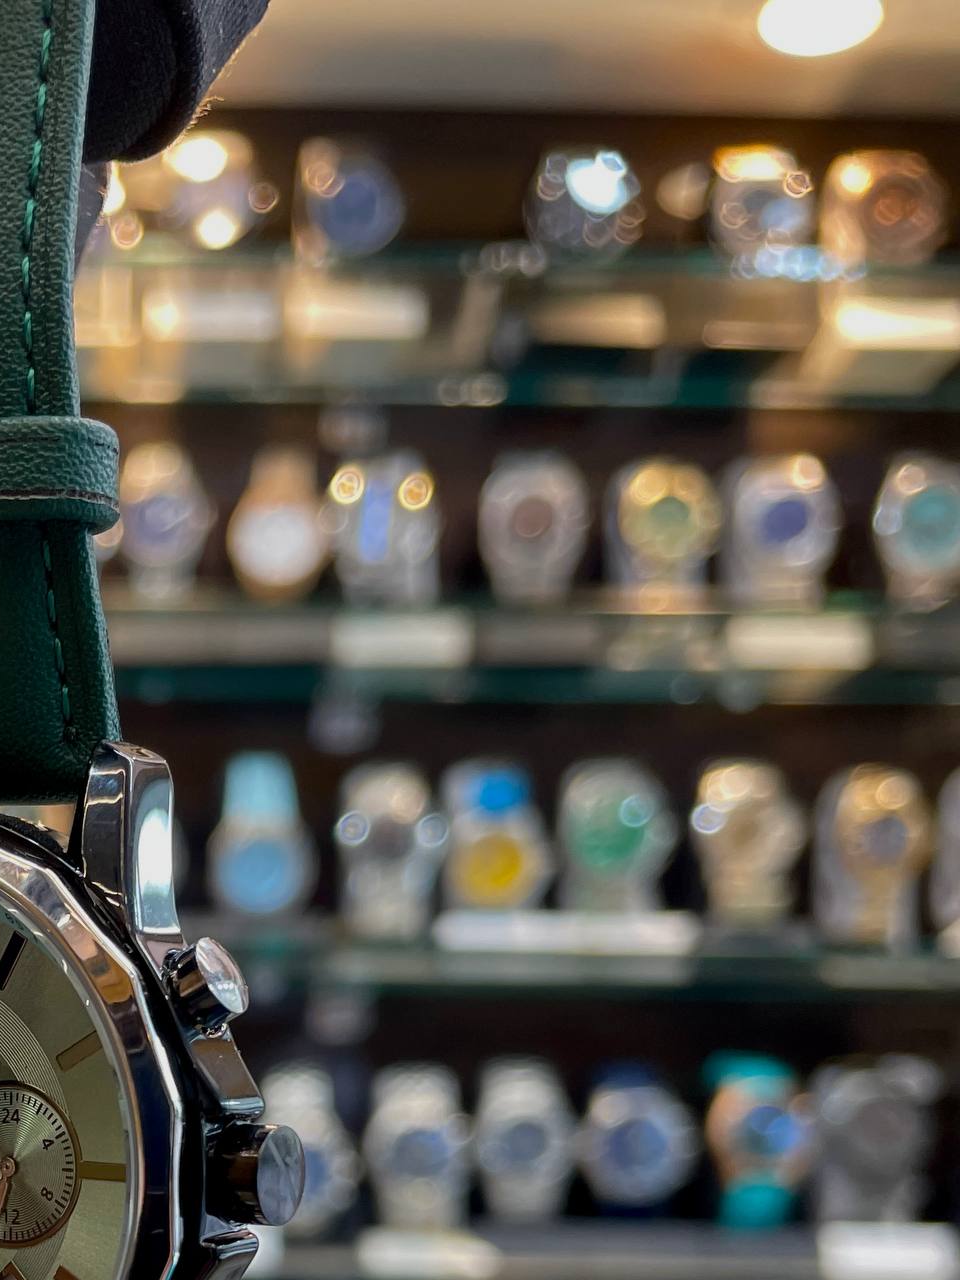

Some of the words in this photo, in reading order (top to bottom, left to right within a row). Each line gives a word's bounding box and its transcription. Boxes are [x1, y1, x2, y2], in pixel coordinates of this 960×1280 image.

[1, 1108, 21, 1125] 24
[42, 1138, 55, 1151] 4
[40, 1186, 54, 1202] 8
